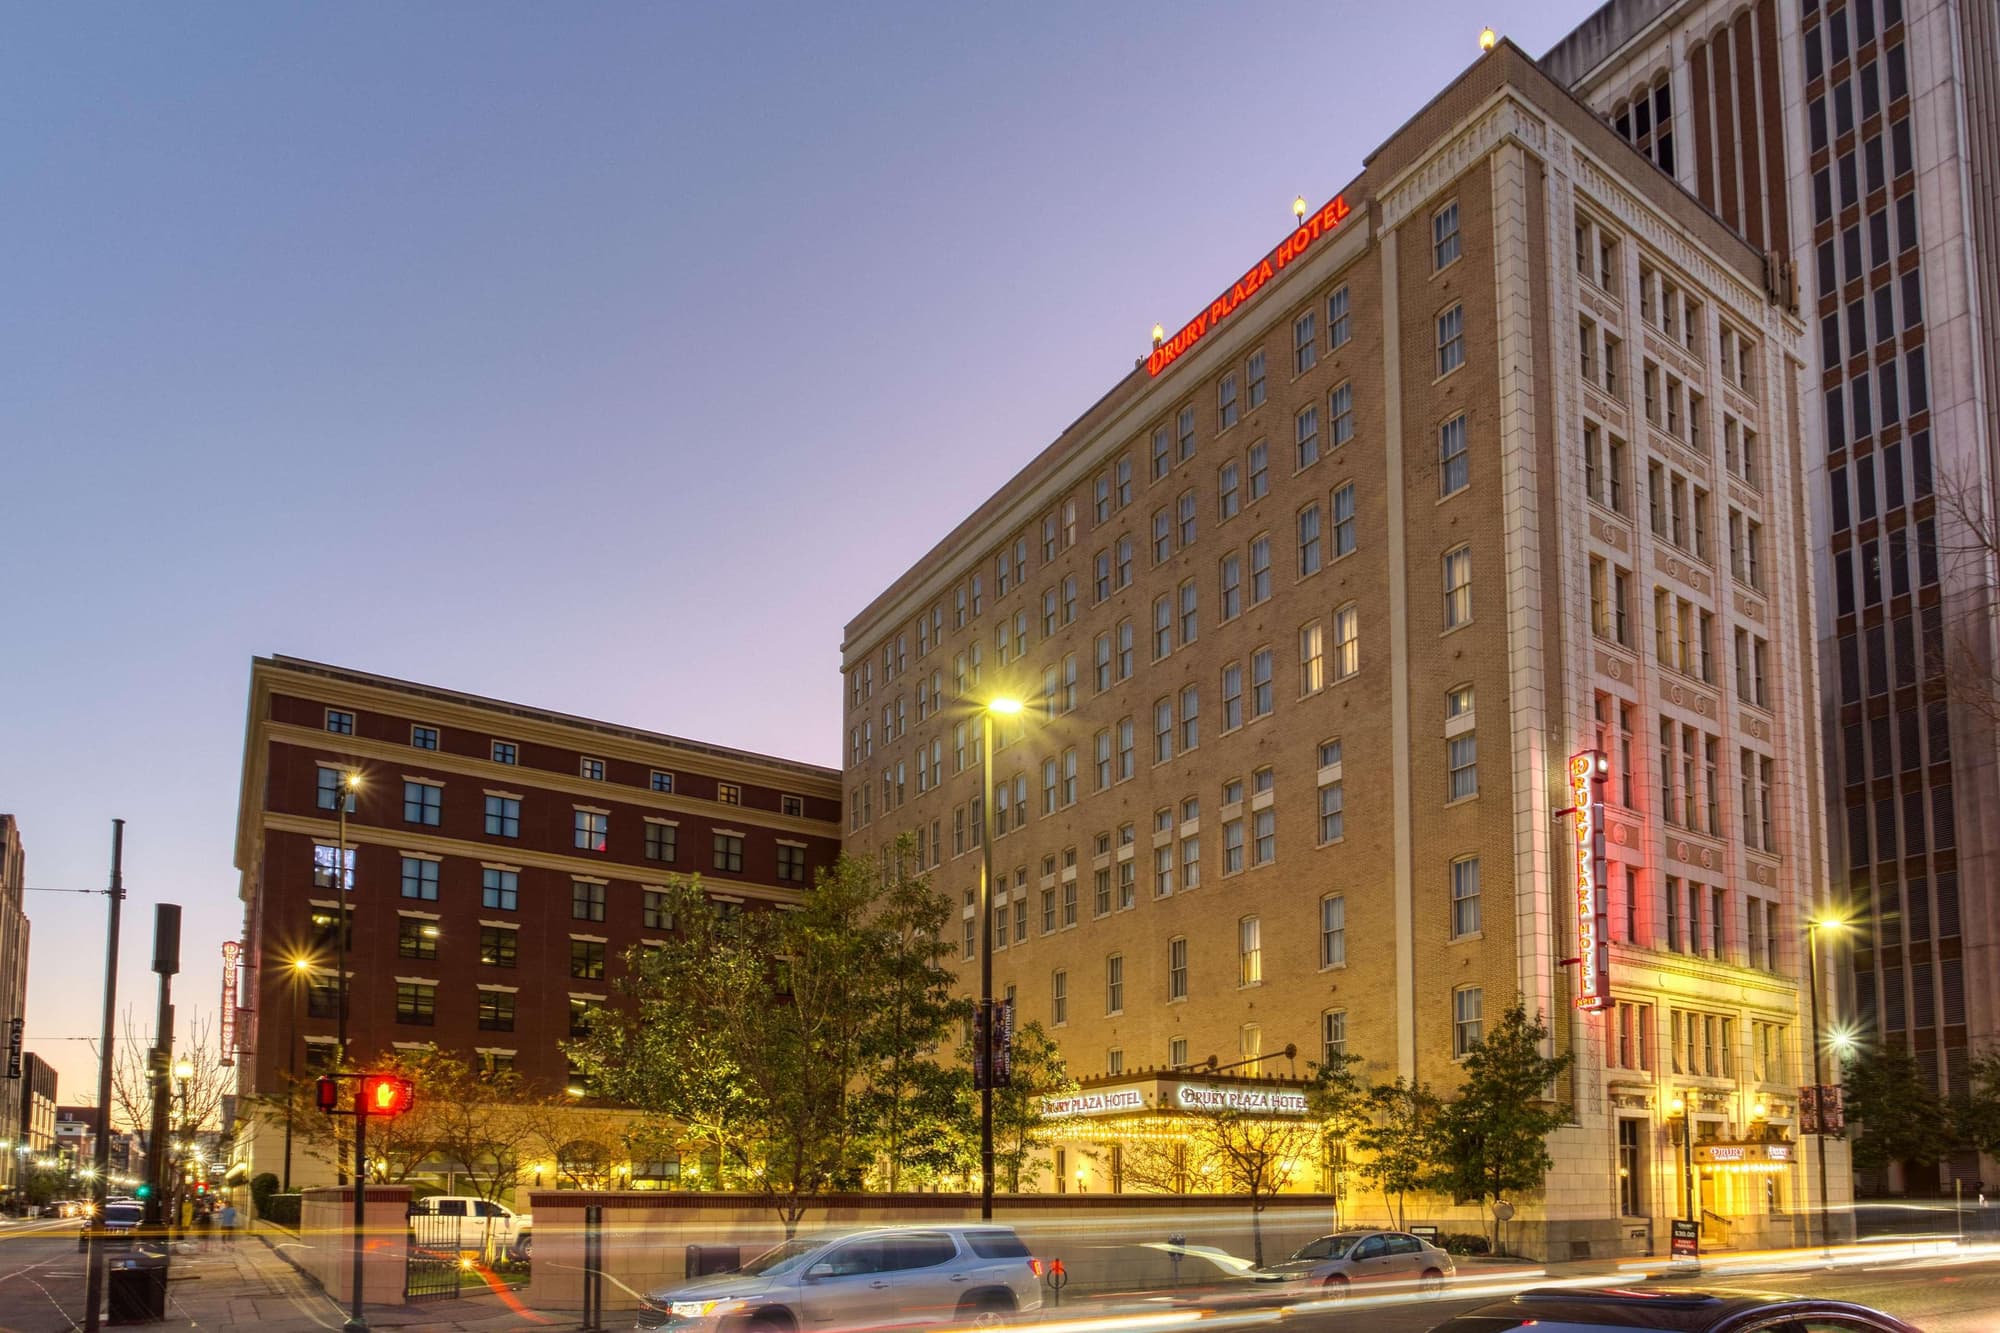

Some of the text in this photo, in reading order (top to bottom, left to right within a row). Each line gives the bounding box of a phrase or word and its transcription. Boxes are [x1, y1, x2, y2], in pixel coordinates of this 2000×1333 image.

[1148, 195, 1350, 377] DRURY PLAZA HOTEL
[1571, 757, 1591, 991] DRURY PLAZA HOTEL
[224, 944, 236, 985] DRURY
[1004, 1005, 1012, 1043] JANUARY
[11, 1021, 22, 1077] HOTEL
[1071, 1096, 1102, 1111] PLAZA
[1105, 1092, 1140, 1106] HOTEL
[1181, 1088, 1308, 1109] DRURY PLAZA HOTEL
[1710, 1147, 1744, 1157] DRURY
